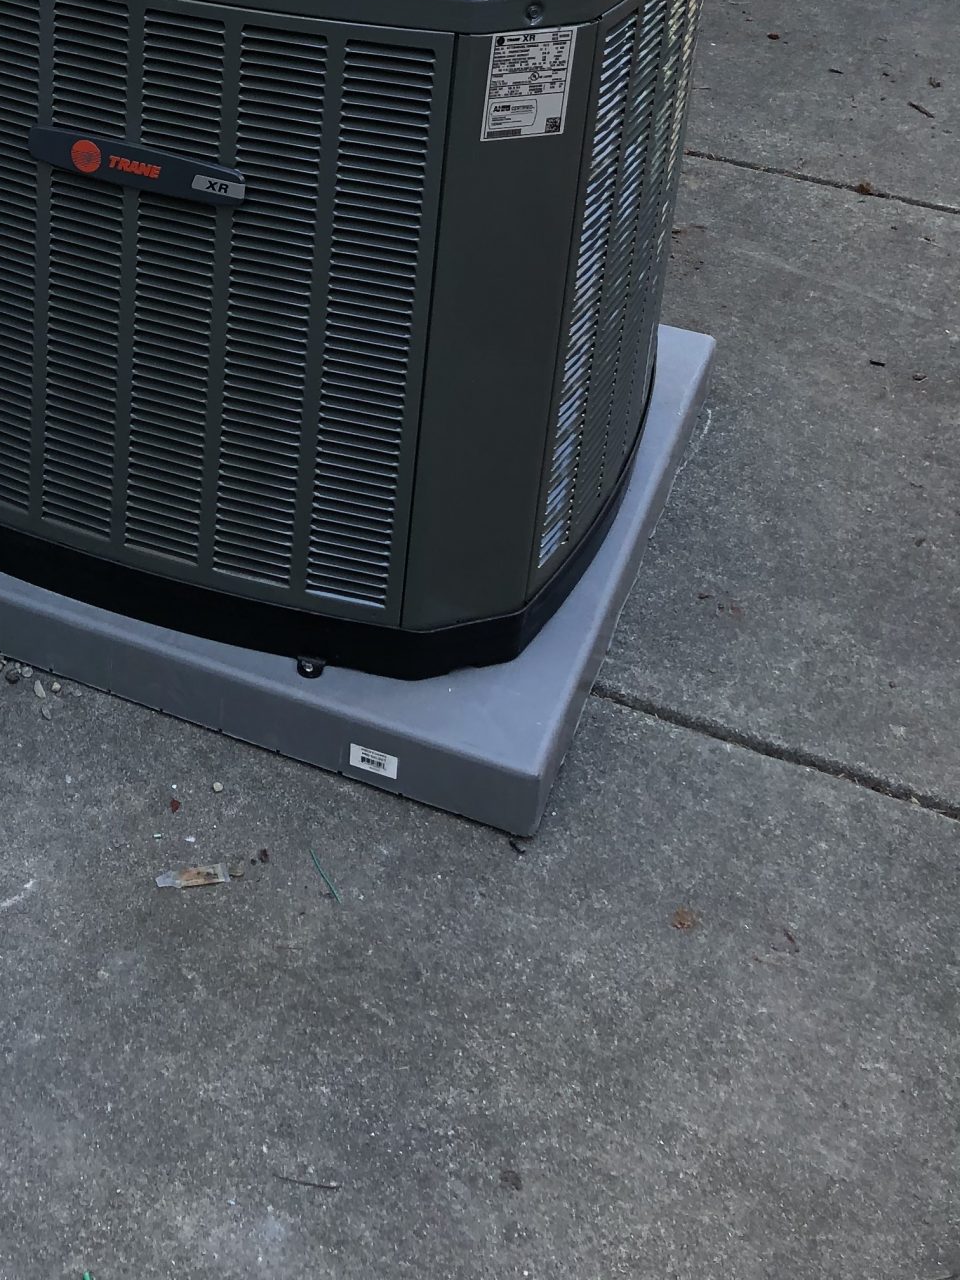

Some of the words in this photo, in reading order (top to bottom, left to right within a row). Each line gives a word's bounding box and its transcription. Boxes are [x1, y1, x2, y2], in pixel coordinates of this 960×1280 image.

[522, 34, 536, 42] XR
[109, 155, 162, 179] TRANE
[205, 180, 229, 194] XR
